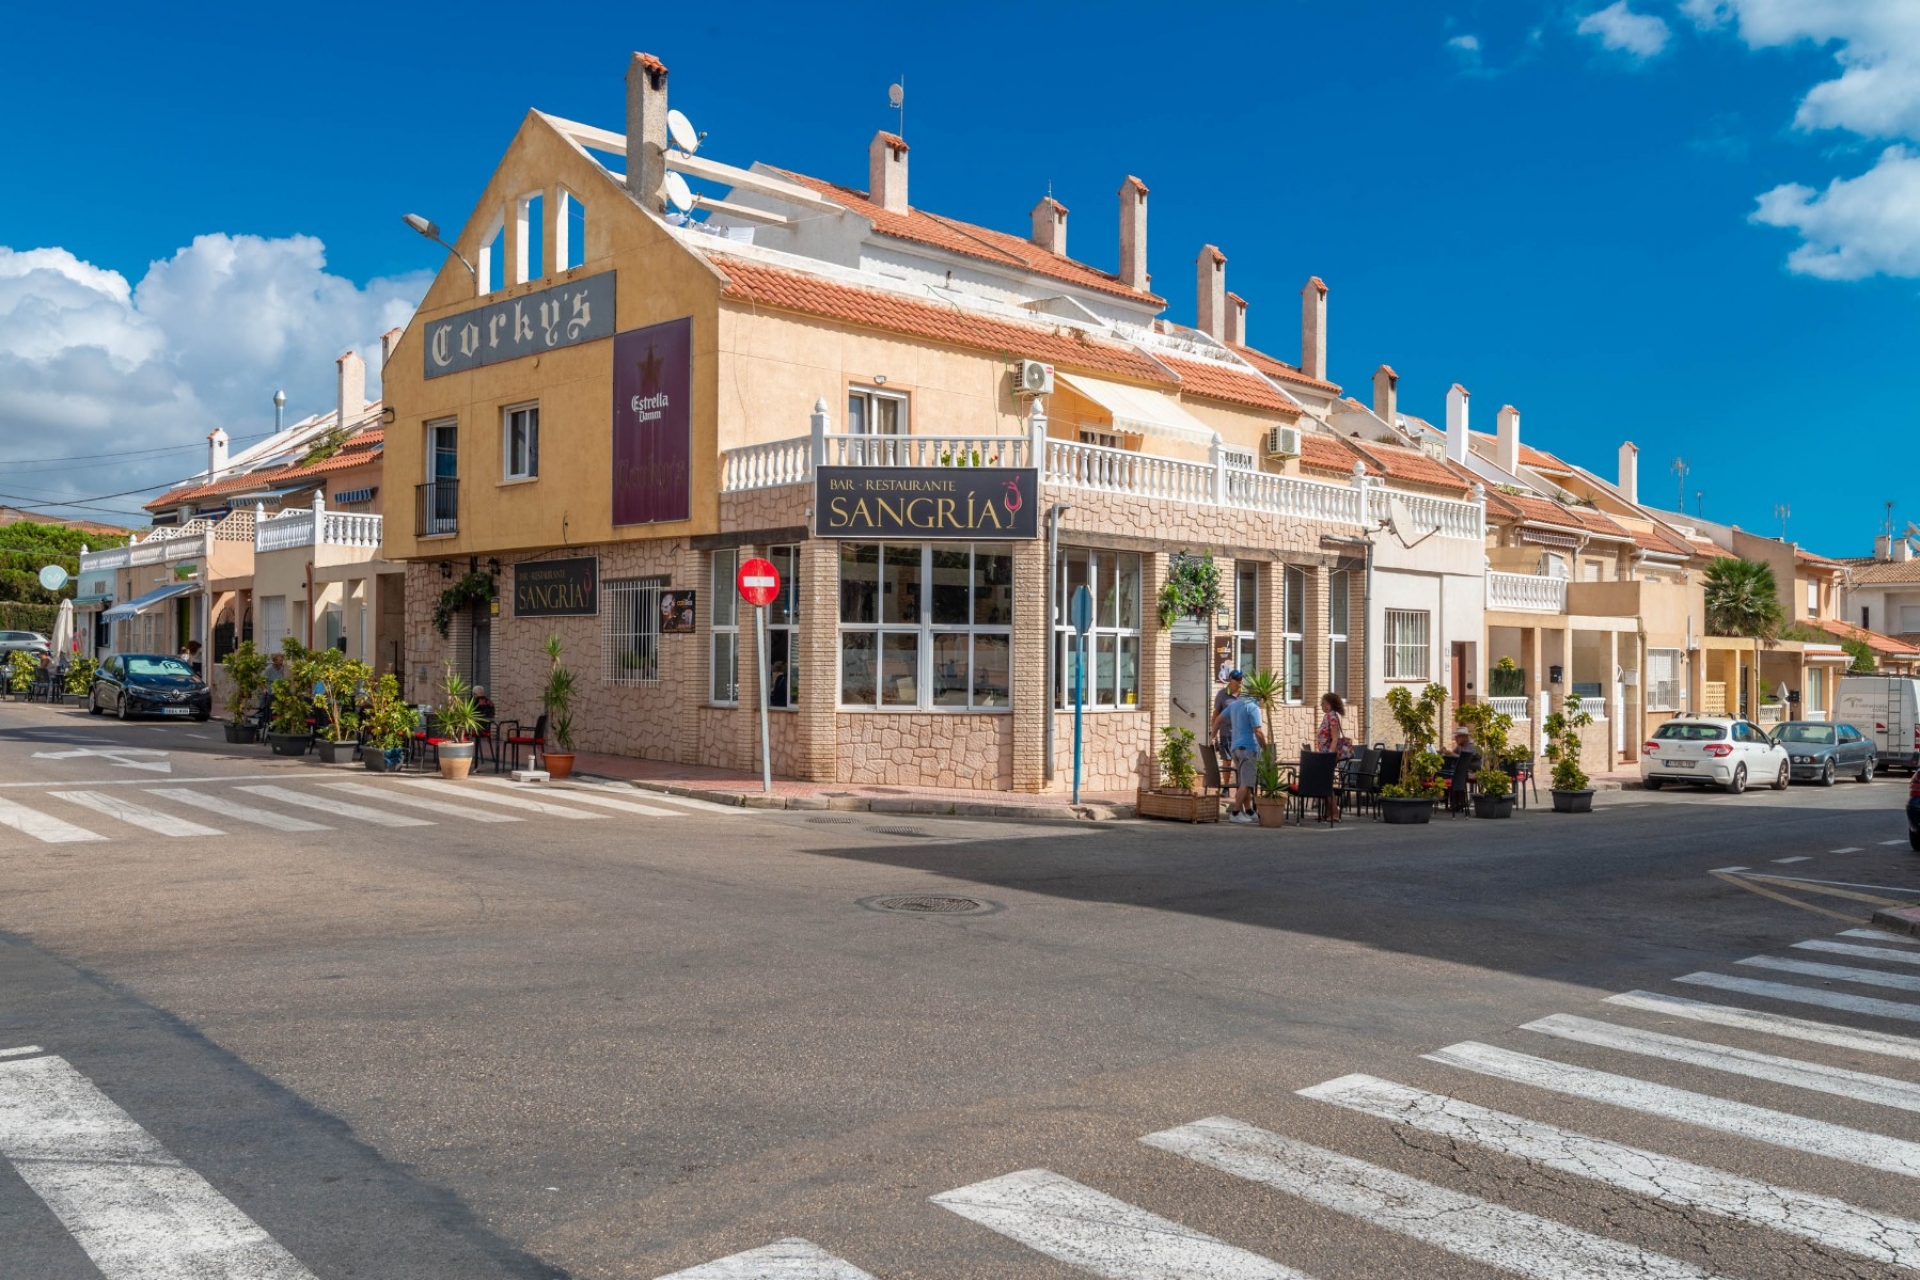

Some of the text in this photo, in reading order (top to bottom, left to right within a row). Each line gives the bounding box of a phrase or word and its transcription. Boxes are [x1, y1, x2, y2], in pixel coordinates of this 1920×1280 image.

[432, 289, 592, 367] Corky's
[631, 393, 669, 412] Estrella
[639, 410, 661, 422] Damm
[830, 479, 855, 490] BAR
[866, 479, 956, 492] RESTAURANTE
[830, 491, 1002, 529] SANGRÍA
[519, 577, 584, 610] SANGRÍA
